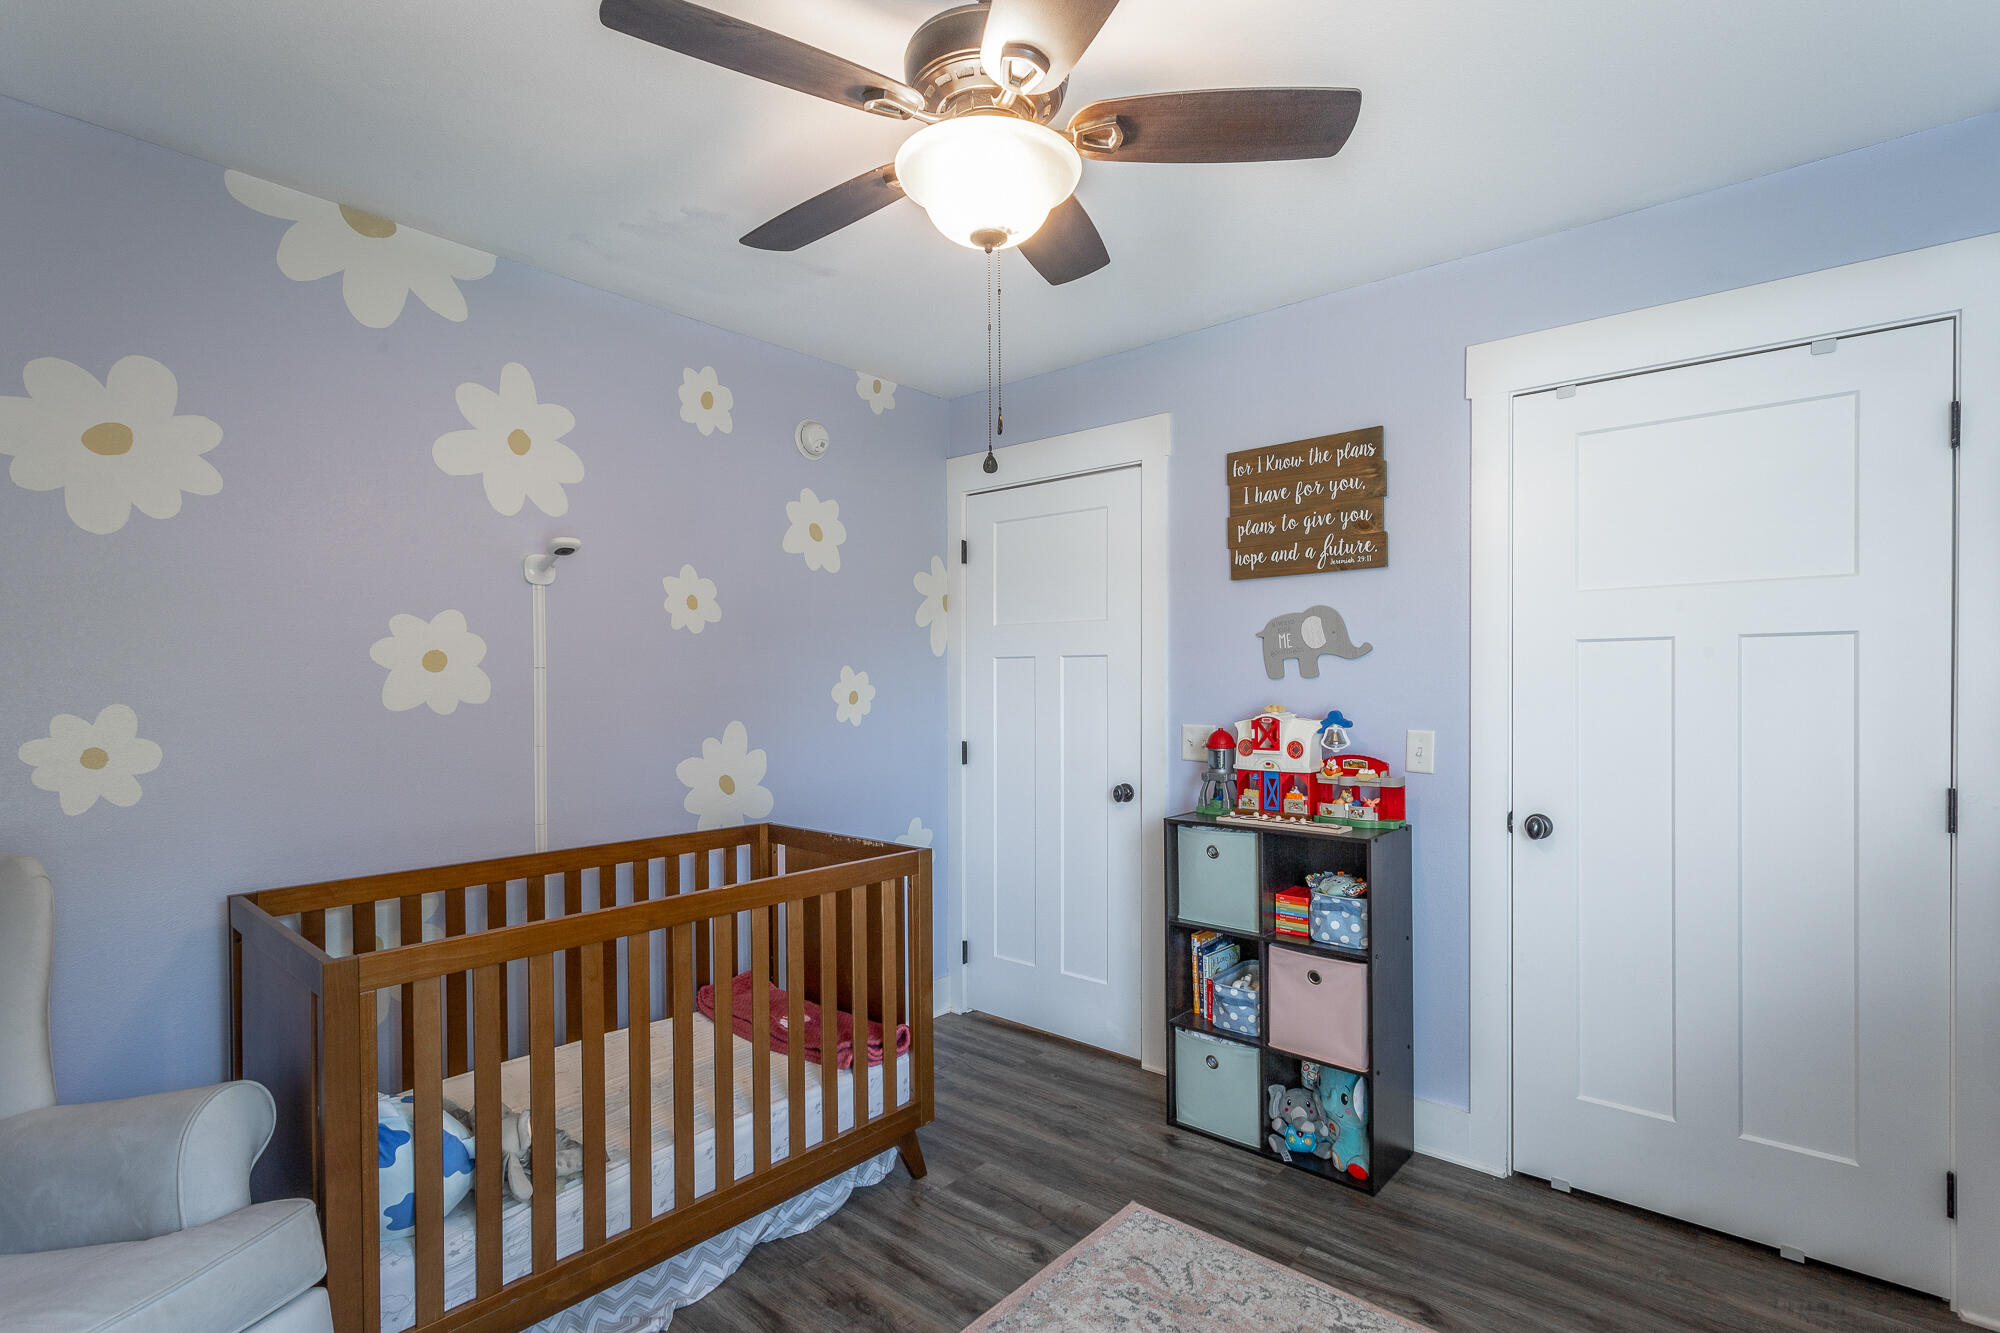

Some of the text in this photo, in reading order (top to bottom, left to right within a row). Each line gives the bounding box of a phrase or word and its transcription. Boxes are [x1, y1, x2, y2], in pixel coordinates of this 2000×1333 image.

[1257, 455, 1263, 474] I
[1308, 446, 1333, 466] the
[1336, 441, 1377, 468] plans
[1243, 486, 1250, 505] I
[1254, 485, 1291, 504] have
[1295, 480, 1325, 505] for
[1237, 509, 1373, 544] plans to give you
[1234, 533, 1378, 572] hope and a future.
[1278, 633, 1293, 649] ME
